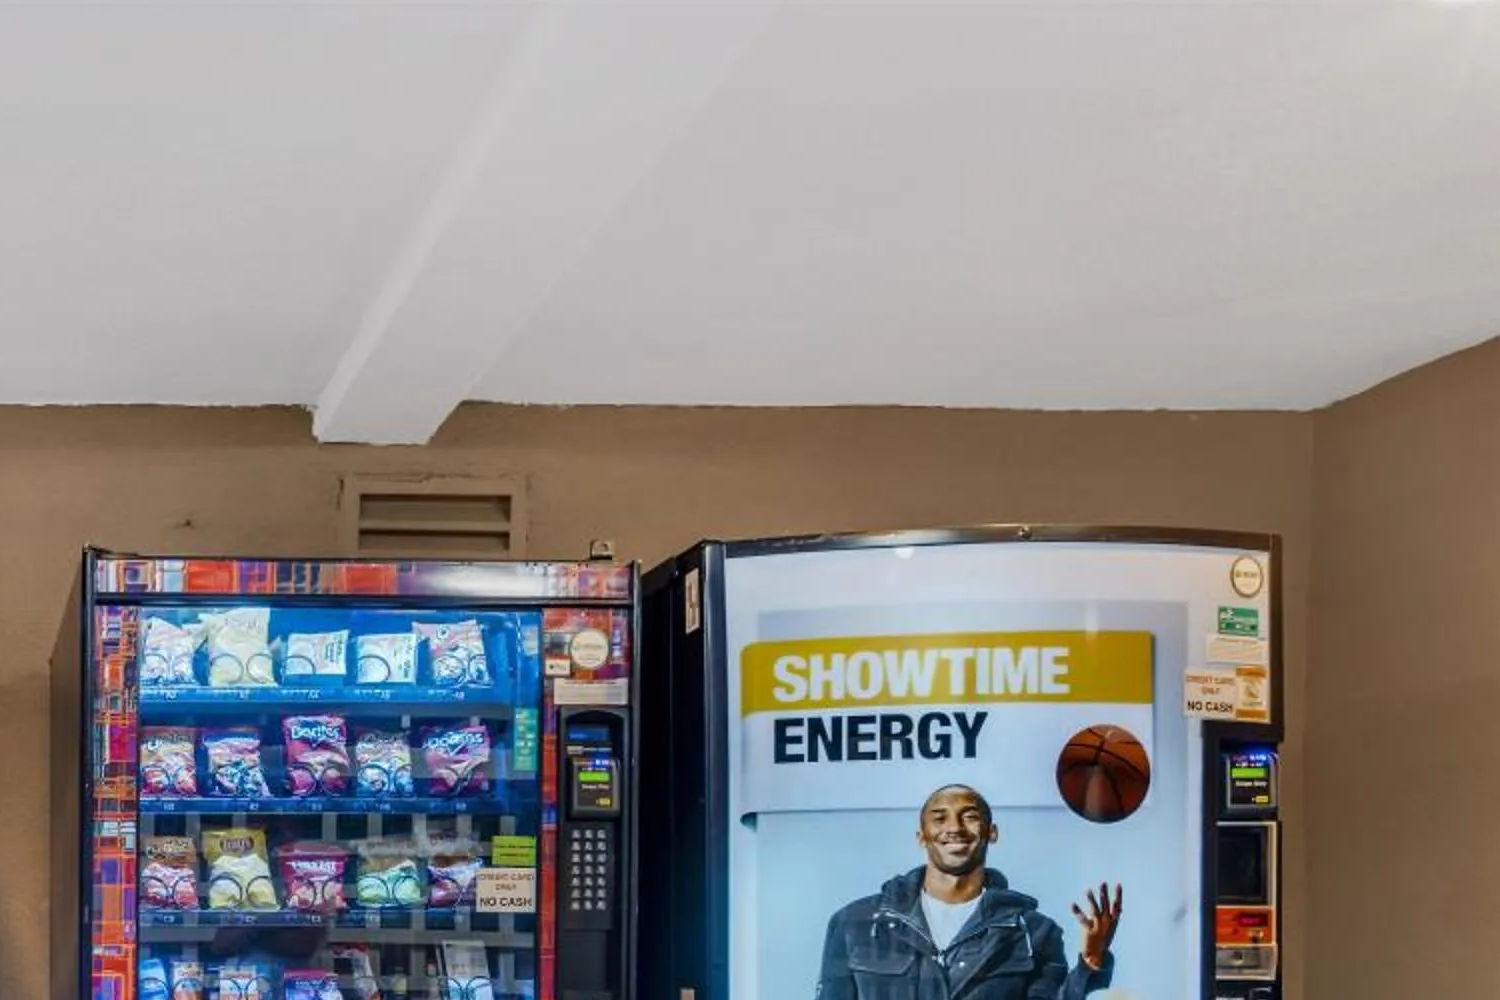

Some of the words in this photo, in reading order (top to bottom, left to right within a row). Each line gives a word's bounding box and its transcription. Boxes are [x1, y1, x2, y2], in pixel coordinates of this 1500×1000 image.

[772, 646, 1071, 703] SHOWTIME
[1187, 700, 1203, 711] NO
[1206, 701, 1233, 712] CASH
[773, 711, 989, 764] ENERGY
[480, 897, 498, 907] NO
[500, 897, 533, 907] CASH
